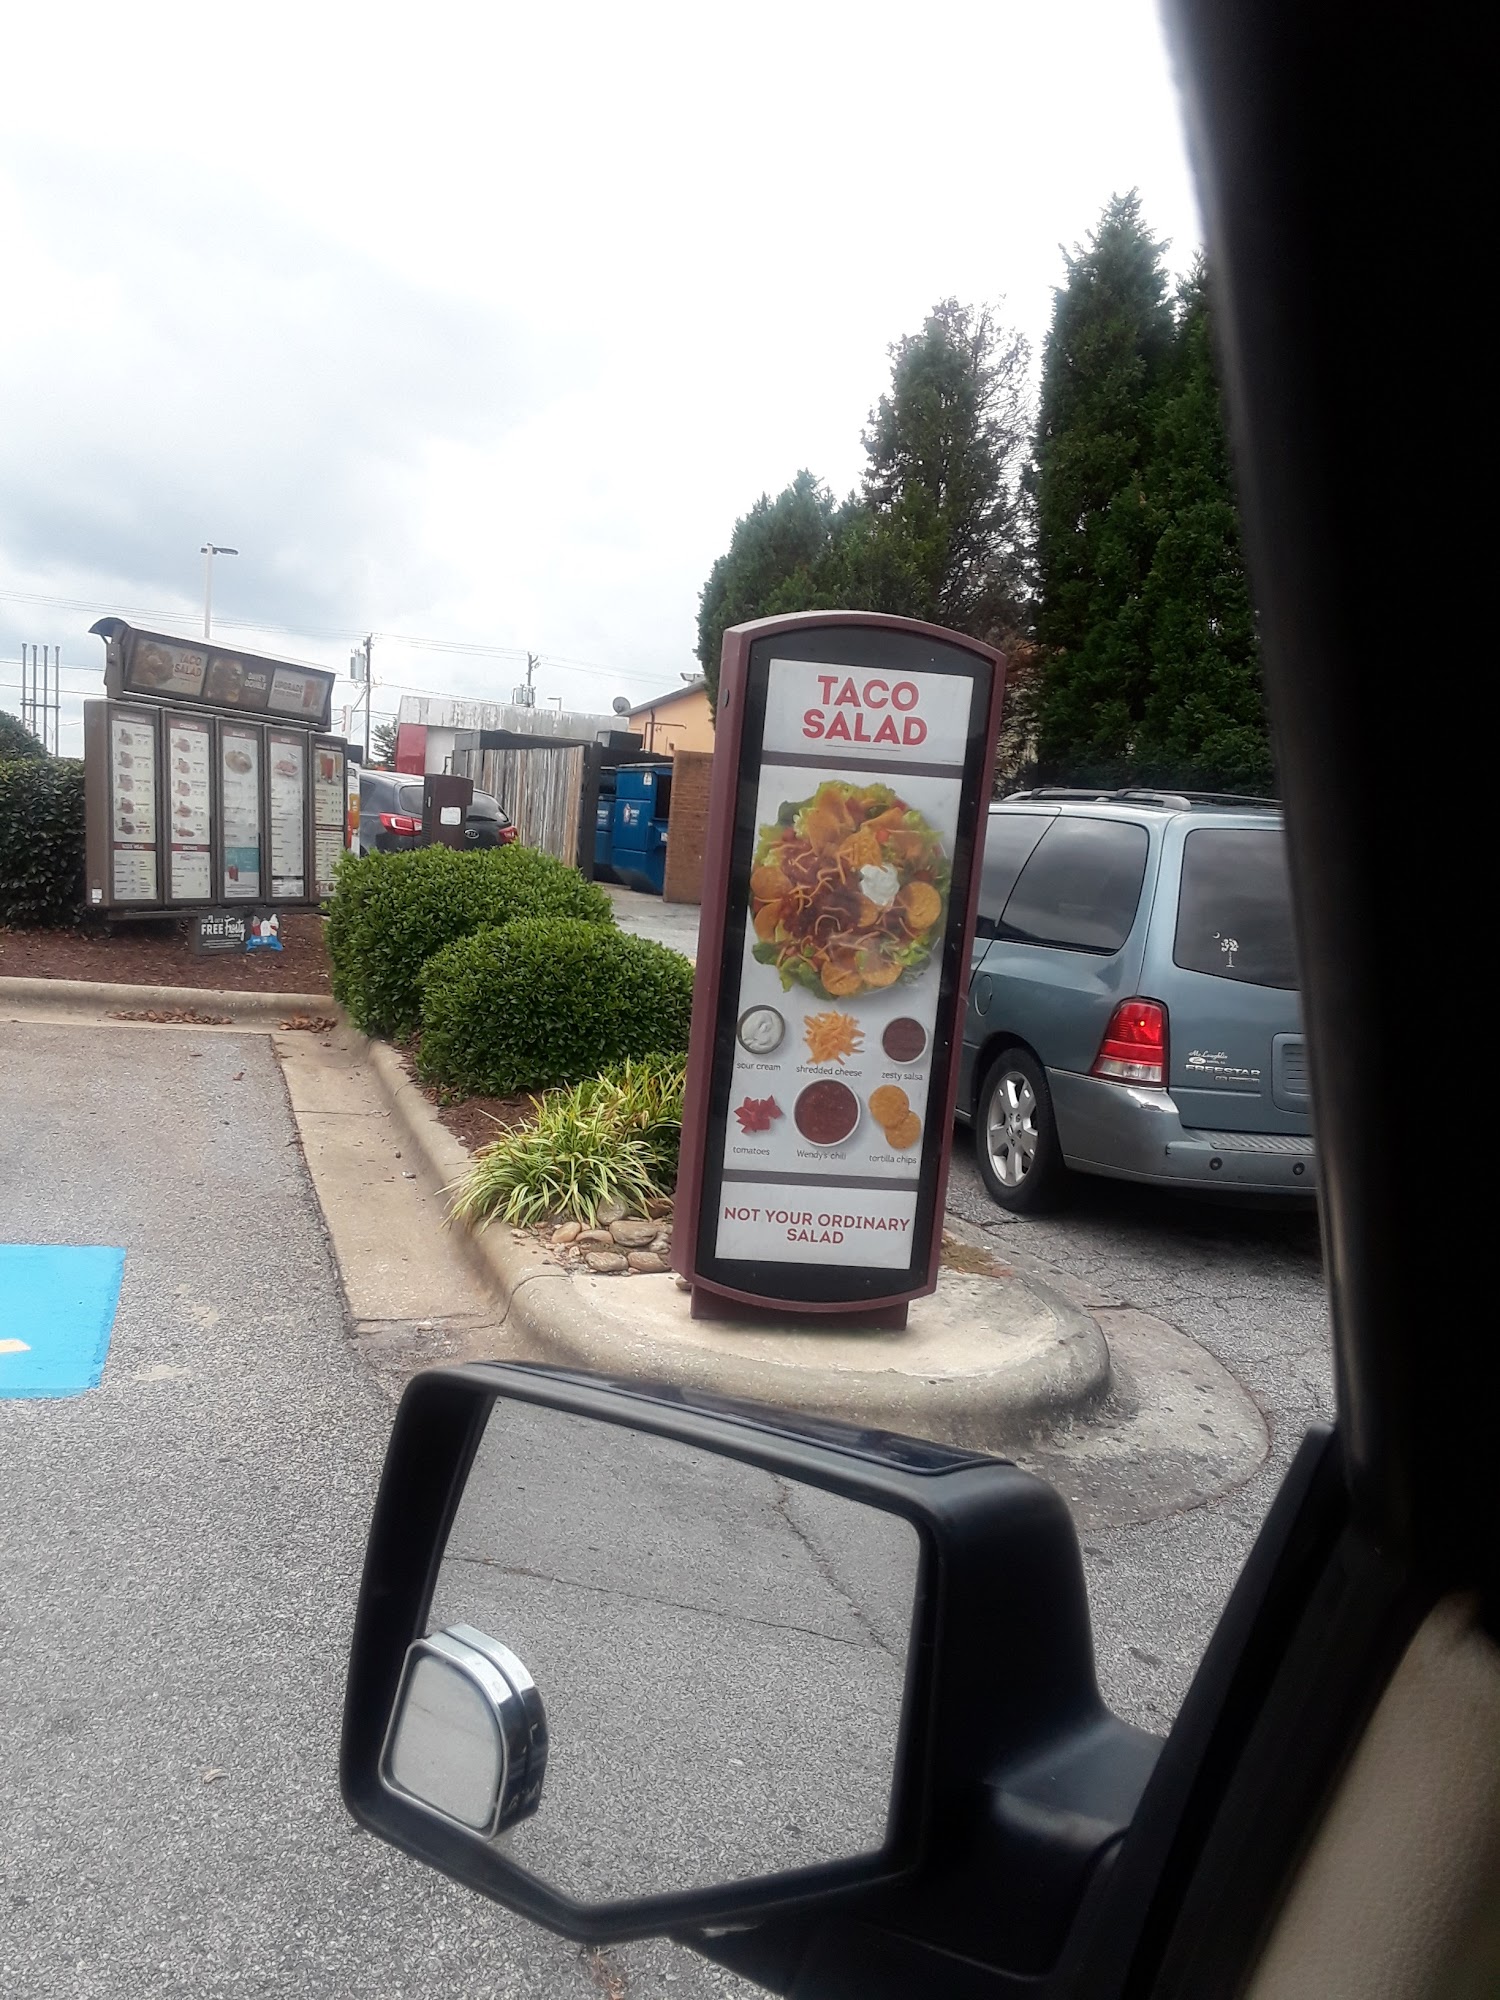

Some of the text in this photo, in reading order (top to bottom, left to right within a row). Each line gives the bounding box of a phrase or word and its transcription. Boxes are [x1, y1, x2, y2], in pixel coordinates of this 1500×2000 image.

[173, 663, 202, 677] SALAD
[817, 675, 920, 712] TACO
[802, 708, 928, 746] SALAD
[200, 923, 224, 936] FREE
[736, 1062, 781, 1071] sour cream
[796, 1065, 863, 1077] shredded cheese
[1185, 1064, 1261, 1076] FREESTAR
[881, 1071, 924, 1081] zesty salsa
[732, 1146, 770, 1156] tomatoes
[796, 1149, 847, 1161] Wendy's chili
[869, 1154, 917, 1166] tortilla chips
[724, 1206, 911, 1232] NOT YOUR ORDINARY
[786, 1228, 845, 1244] SALAD
